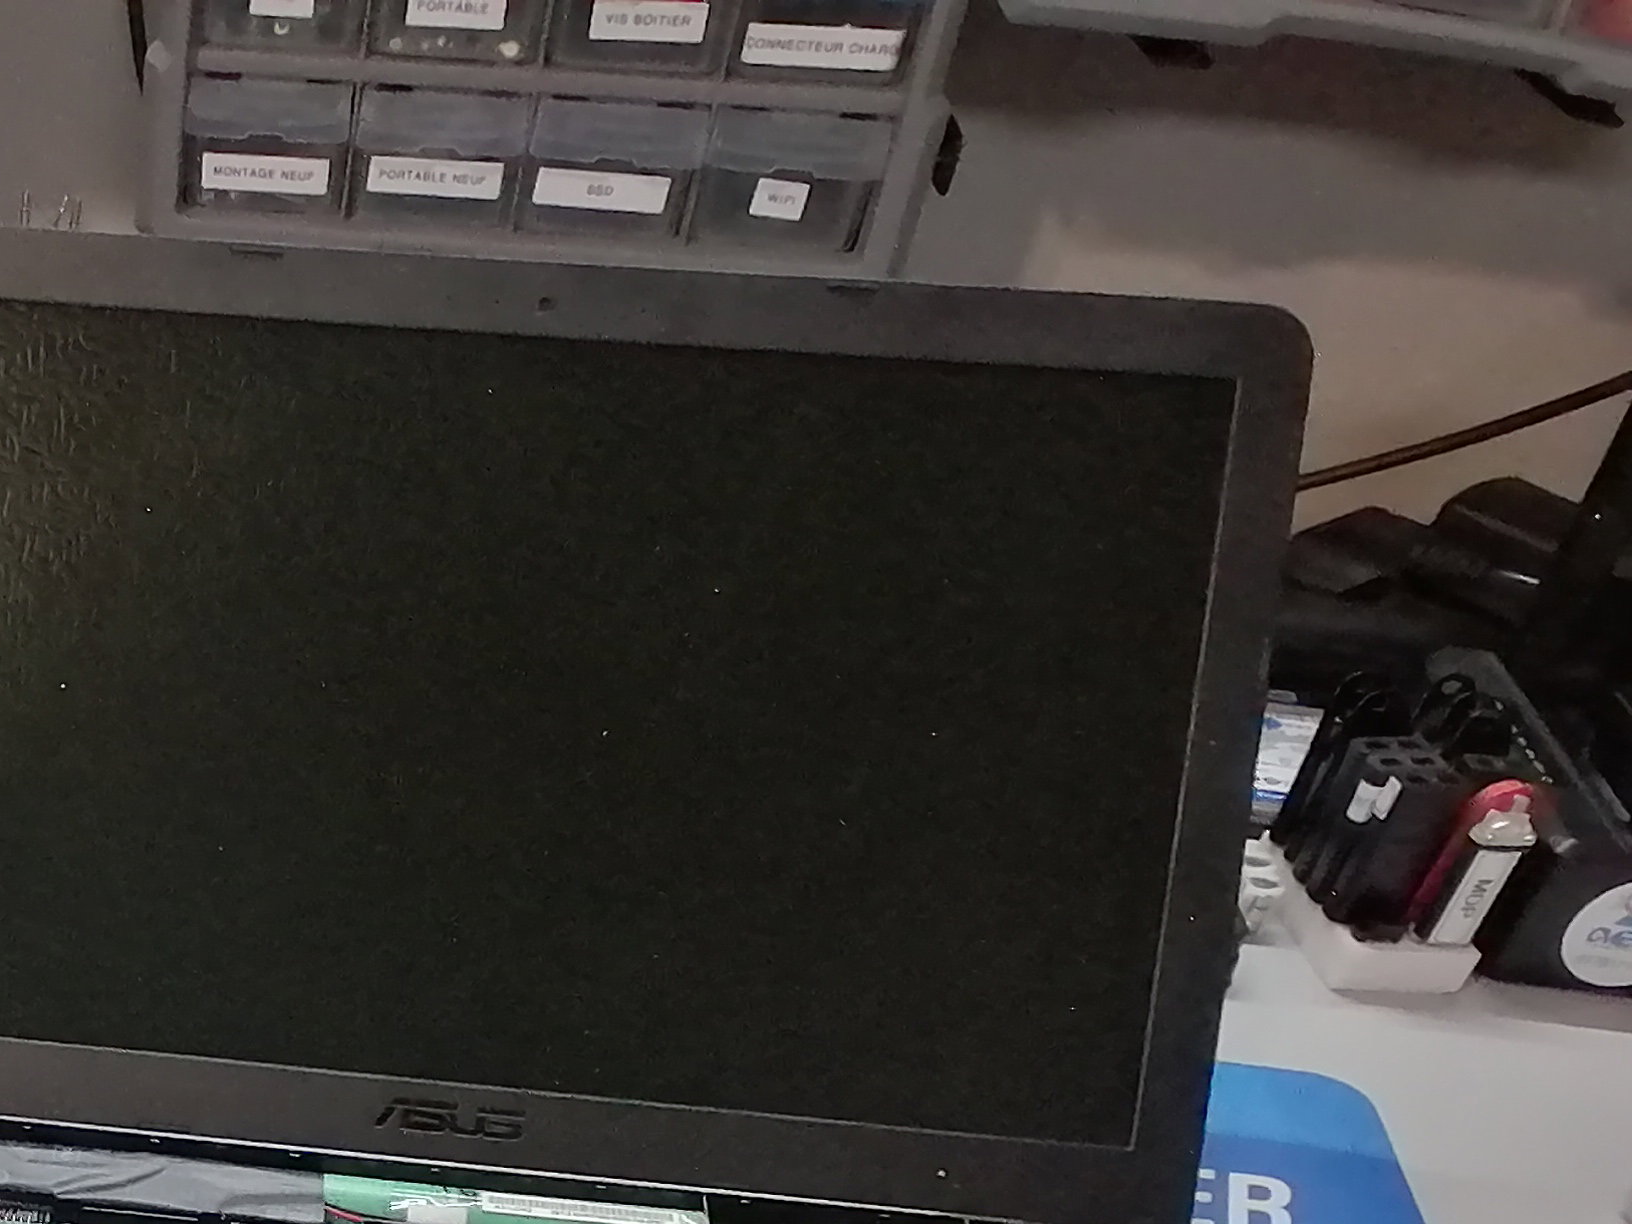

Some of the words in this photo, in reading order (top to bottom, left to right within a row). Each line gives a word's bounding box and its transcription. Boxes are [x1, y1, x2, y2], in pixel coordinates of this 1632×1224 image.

[606, 14, 630, 26] VIS
[633, 14, 692, 27] BOITIER
[747, 36, 843, 53] CONNECTEUR
[213, 166, 275, 179] MONTAGE
[378, 168, 446, 184] PORTABLE
[373, 1099, 528, 1142] ASUS
